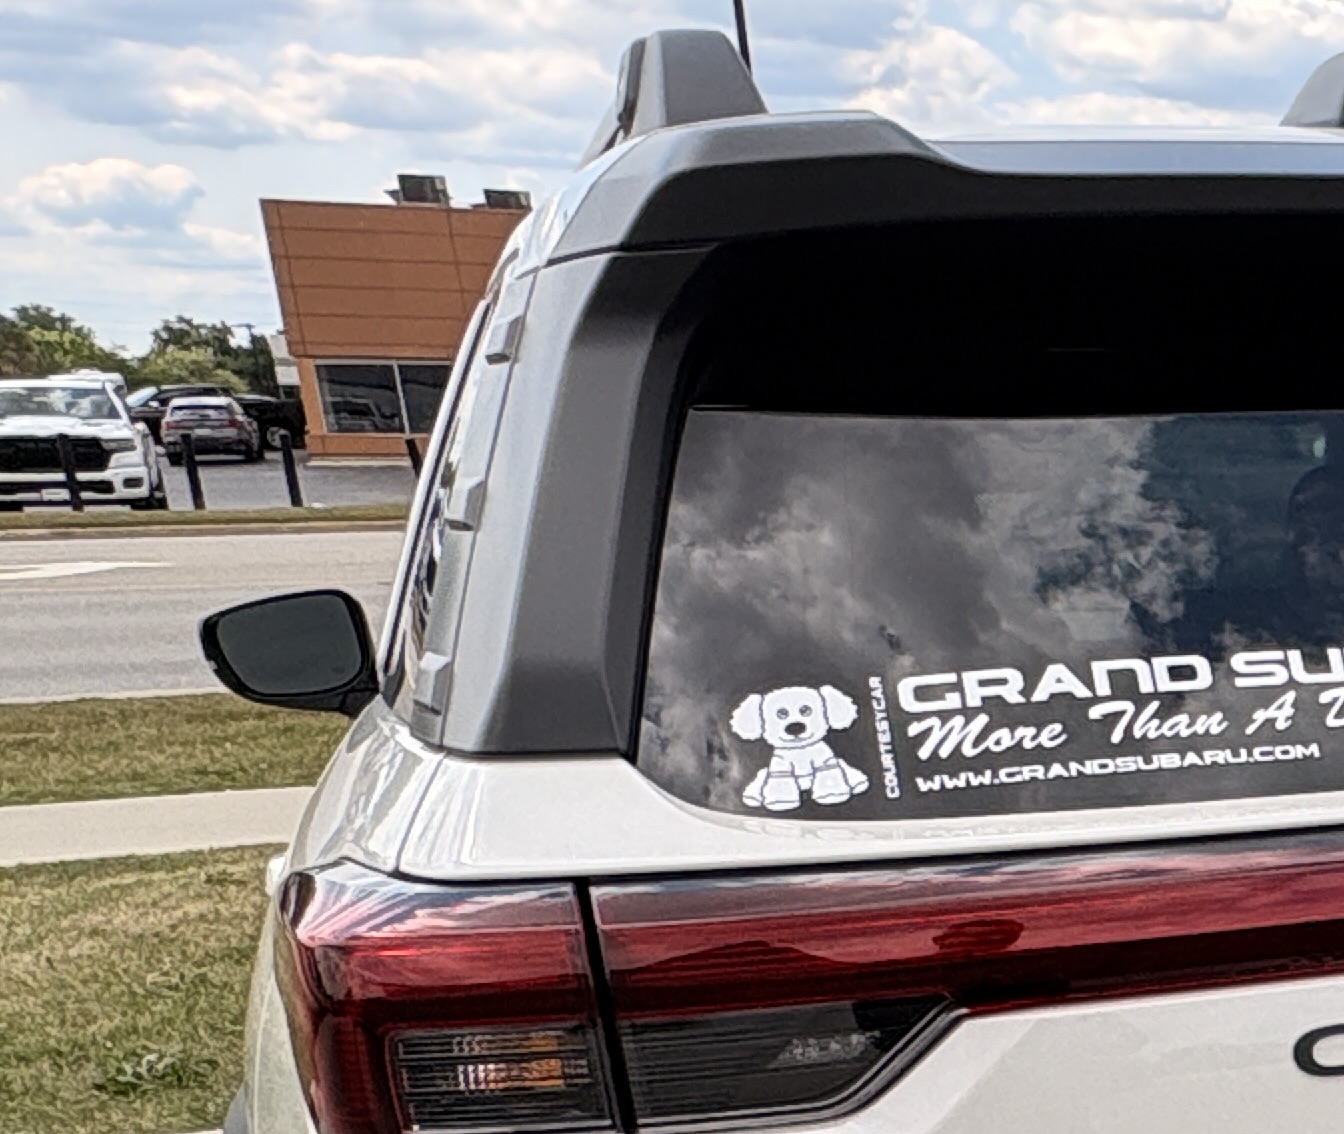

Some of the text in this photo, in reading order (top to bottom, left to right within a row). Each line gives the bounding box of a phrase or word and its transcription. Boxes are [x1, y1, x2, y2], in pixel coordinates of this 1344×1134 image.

[898, 652, 1214, 715] GRAND
[907, 713, 1066, 762] More
[1088, 697, 1228, 747] Than
[1246, 692, 1295, 733] A
[915, 742, 1321, 794] WWW.GRANDSUBARU.COM
